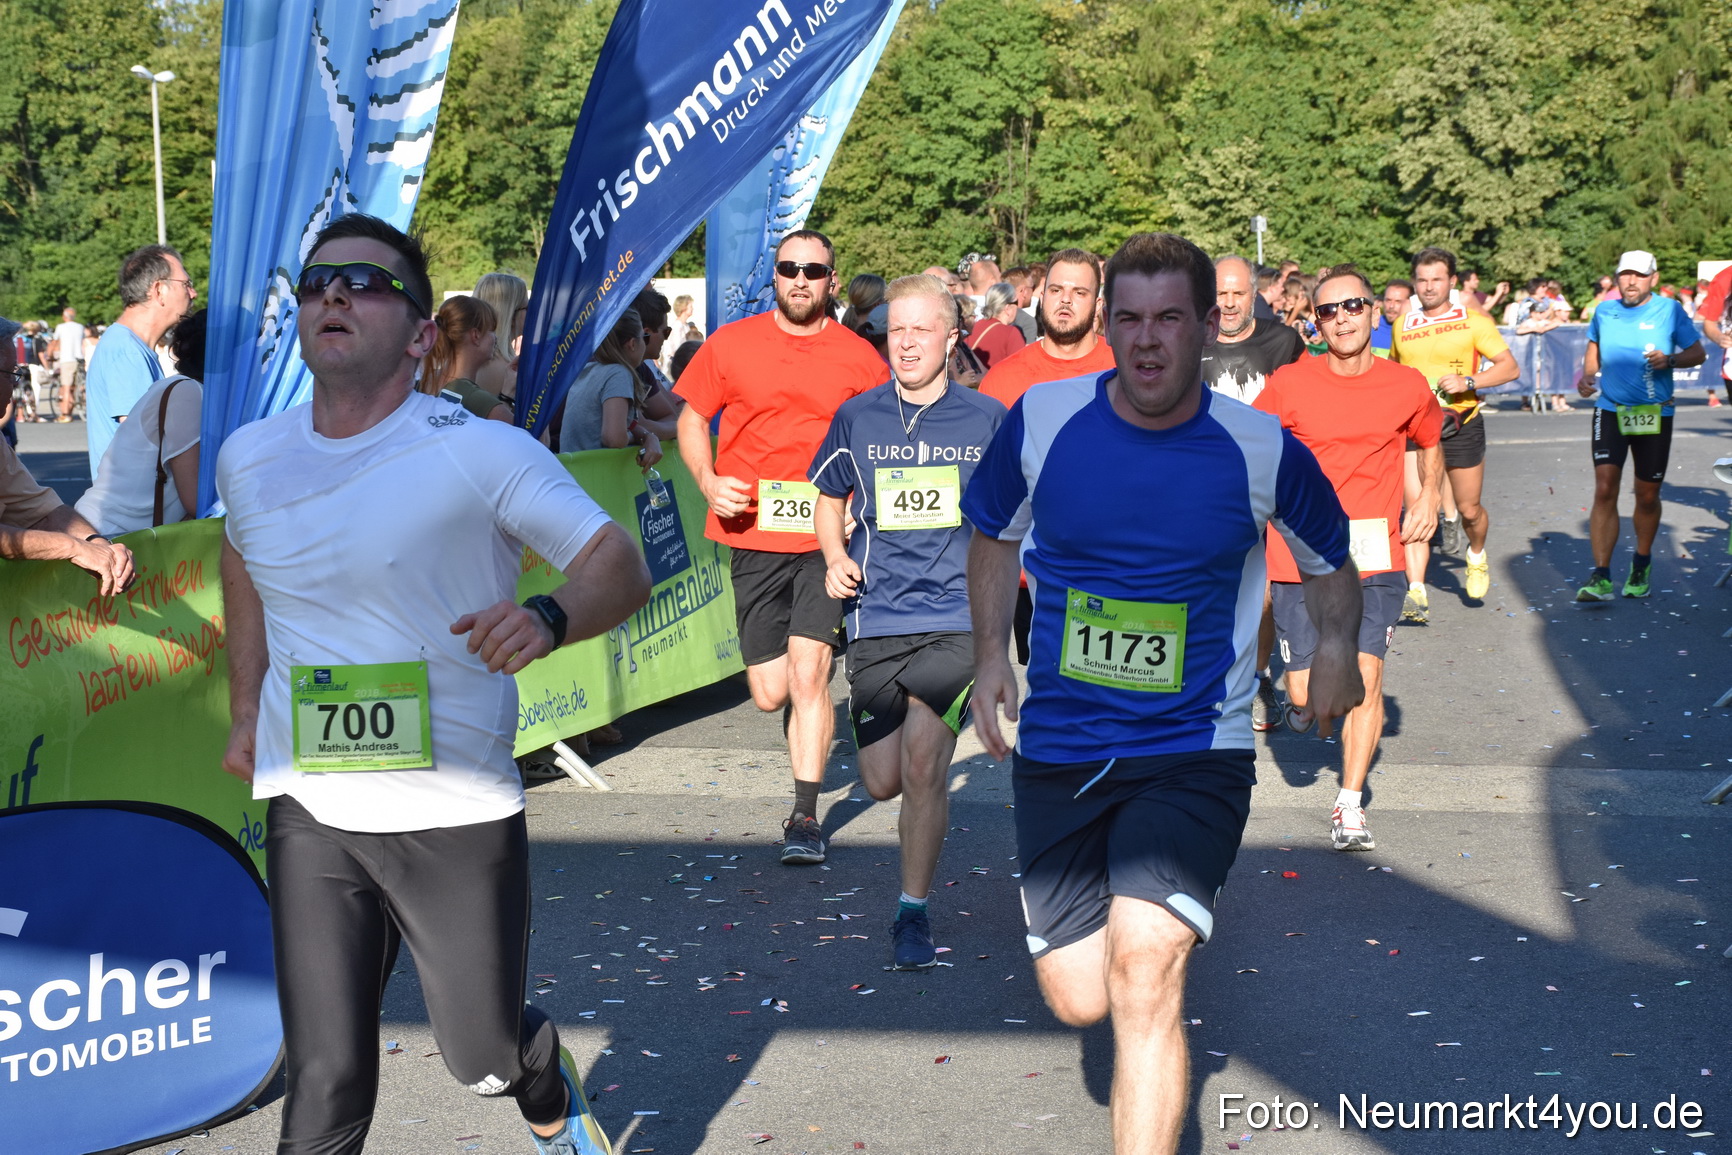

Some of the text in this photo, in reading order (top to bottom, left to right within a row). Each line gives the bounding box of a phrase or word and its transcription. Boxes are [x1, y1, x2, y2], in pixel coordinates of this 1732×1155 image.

[711, 0, 847, 144] Druck und Me
[569, 0, 792, 263] Frischmann
[1401, 323, 1471, 342] MAX BÖGL
[1624, 415, 1655, 427] 2132
[868, 444, 982, 462] EURO POLES
[773, 499, 811, 518] 236
[893, 489, 941, 512] 492
[647, 512, 674, 537] Fischer
[912, 511, 944, 519] Sebastian
[652, 528, 675, 545] AUTOMOBILE
[9, 559, 205, 669] Gesunde Firmen
[642, 622, 688, 663] neumarkt
[1077, 625, 1167, 667] 1173
[1070, 663, 1113, 679] Maschinenbau
[1113, 673, 1147, 683] Silberhorn
[1083, 658, 1155, 676] Schmid Marcus
[78, 643, 161, 717] laufen
[317, 702, 395, 741] 700
[318, 742, 399, 753] Mathis Andreas
